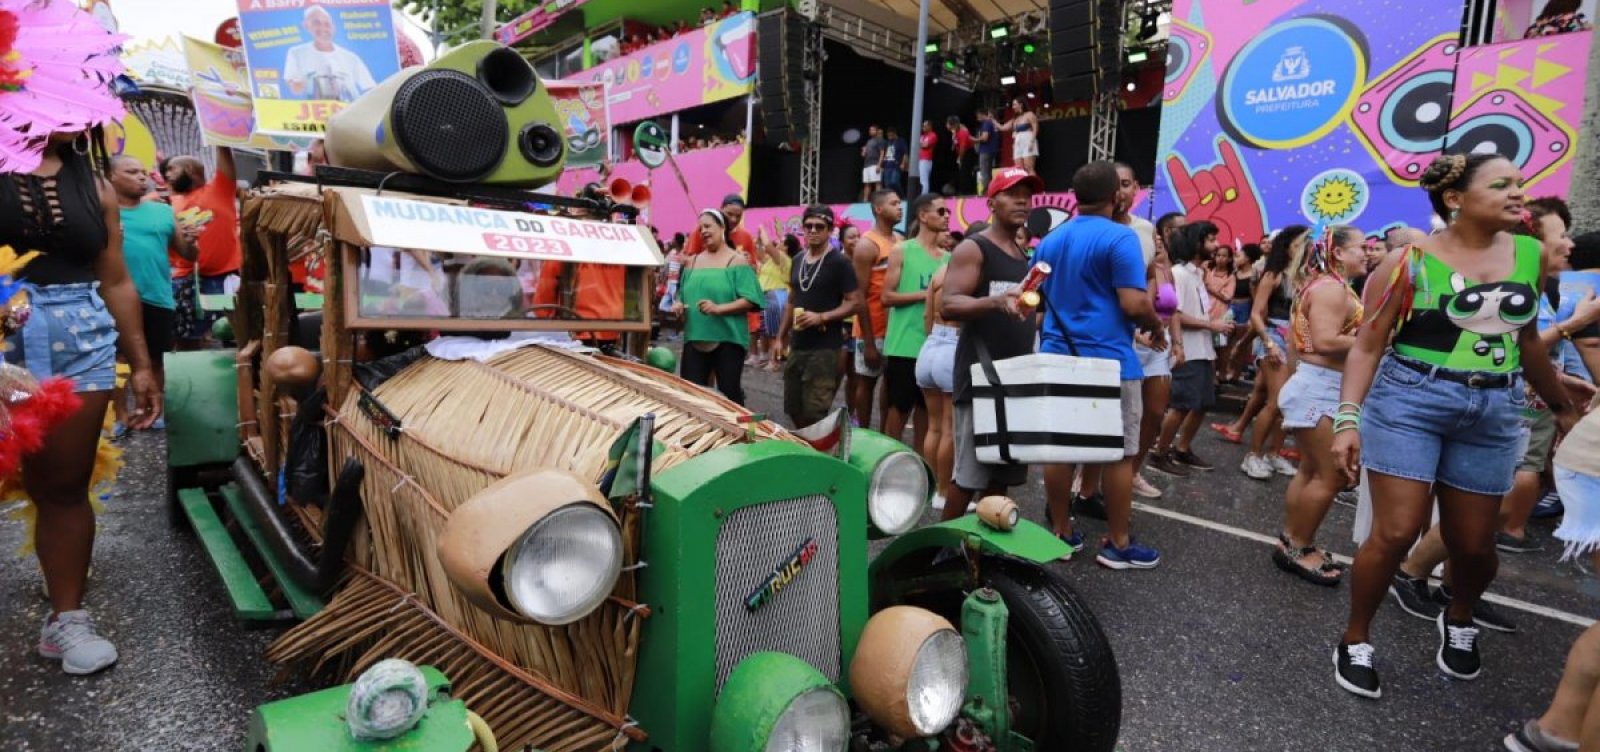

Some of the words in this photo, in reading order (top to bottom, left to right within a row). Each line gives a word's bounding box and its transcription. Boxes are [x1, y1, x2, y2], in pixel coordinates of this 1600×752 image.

[1244, 79, 1336, 105] SALVADOR
[1255, 98, 1320, 113] PREFEITURA
[514, 218, 545, 233] DO
[549, 219, 637, 242] GARCIA
[492, 235, 564, 254] 2023
